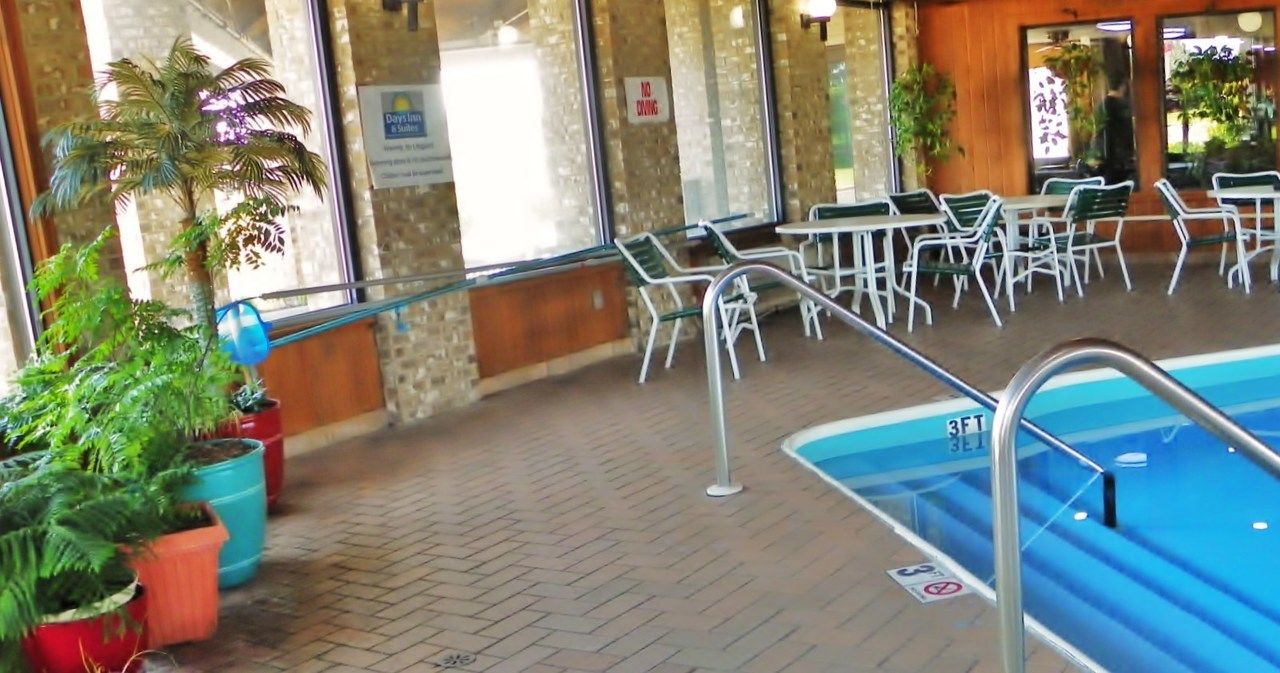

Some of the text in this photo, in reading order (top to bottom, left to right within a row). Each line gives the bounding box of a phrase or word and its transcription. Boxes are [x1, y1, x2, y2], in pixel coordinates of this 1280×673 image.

[641, 82, 651, 97] NO
[637, 99, 658, 116] DIVING
[386, 113, 422, 124] Days Inn
[398, 123, 419, 133] Suites
[949, 414, 983, 436] 3FT
[897, 565, 935, 576] 3
